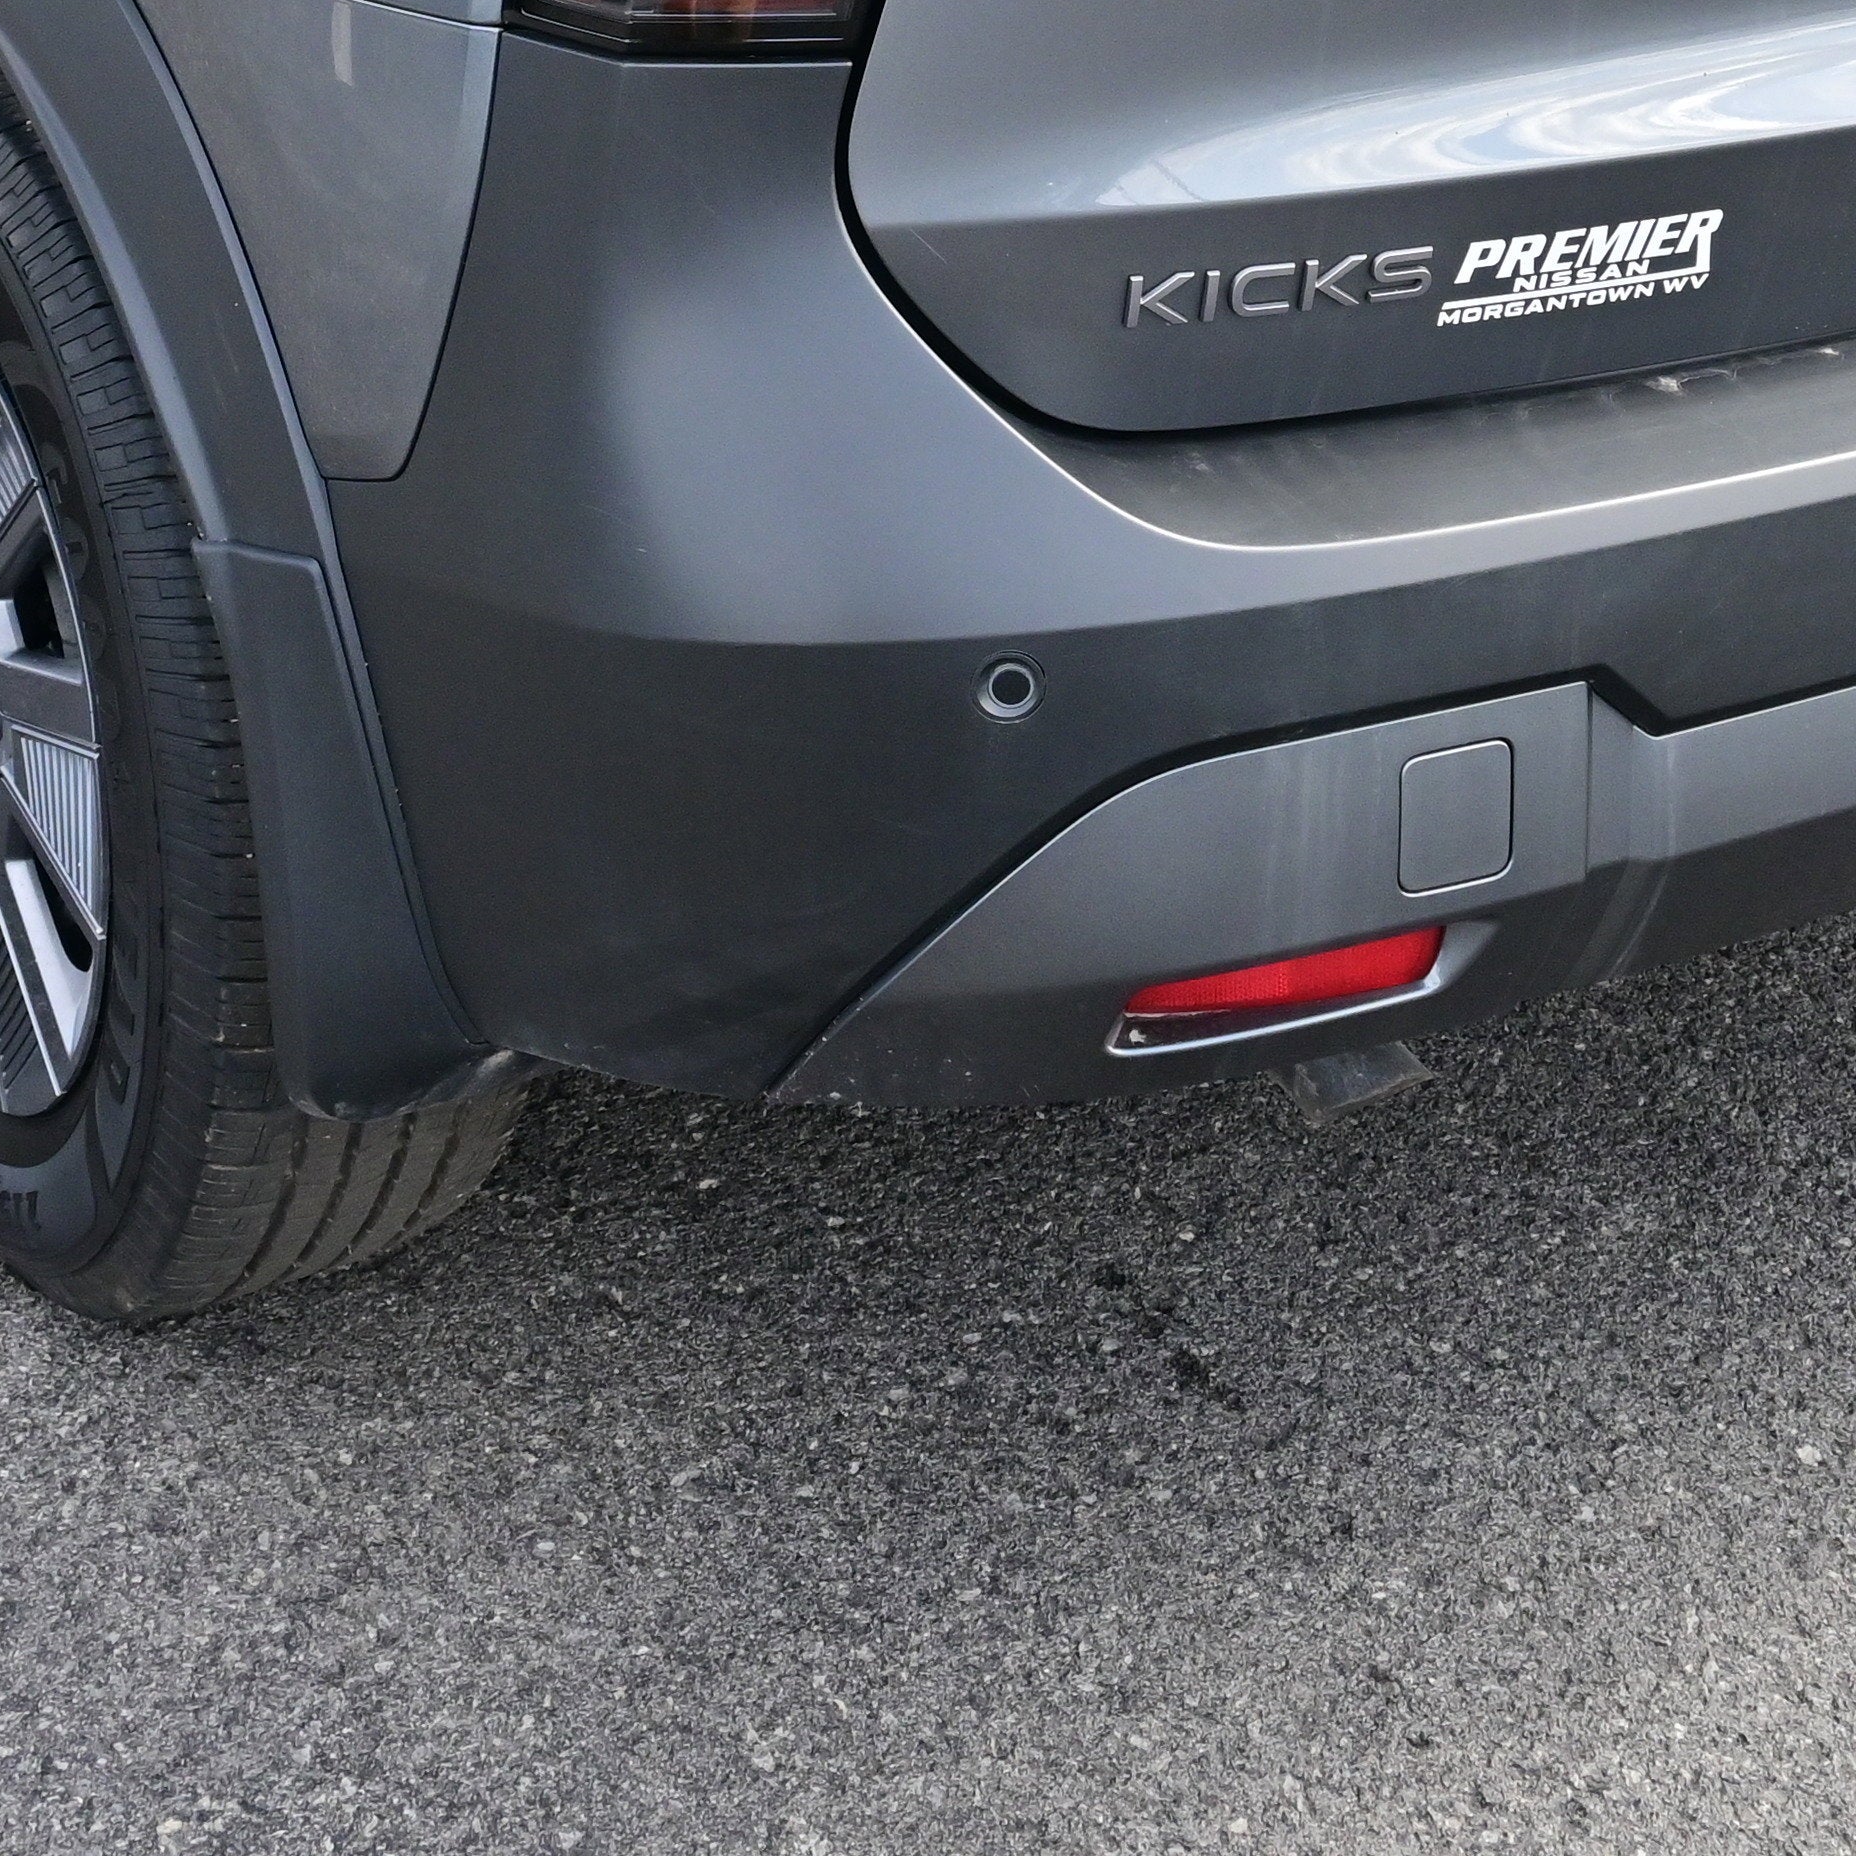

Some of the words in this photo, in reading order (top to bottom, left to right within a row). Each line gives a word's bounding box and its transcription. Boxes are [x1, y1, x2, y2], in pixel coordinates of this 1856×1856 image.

[1453, 208, 1724, 285] PREMIER
[1512, 259, 1651, 293] NISSAN
[1123, 245, 1435, 328] KICKS
[1436, 281, 1656, 327] MORGANTOWN
[1662, 272, 1710, 295] WV
